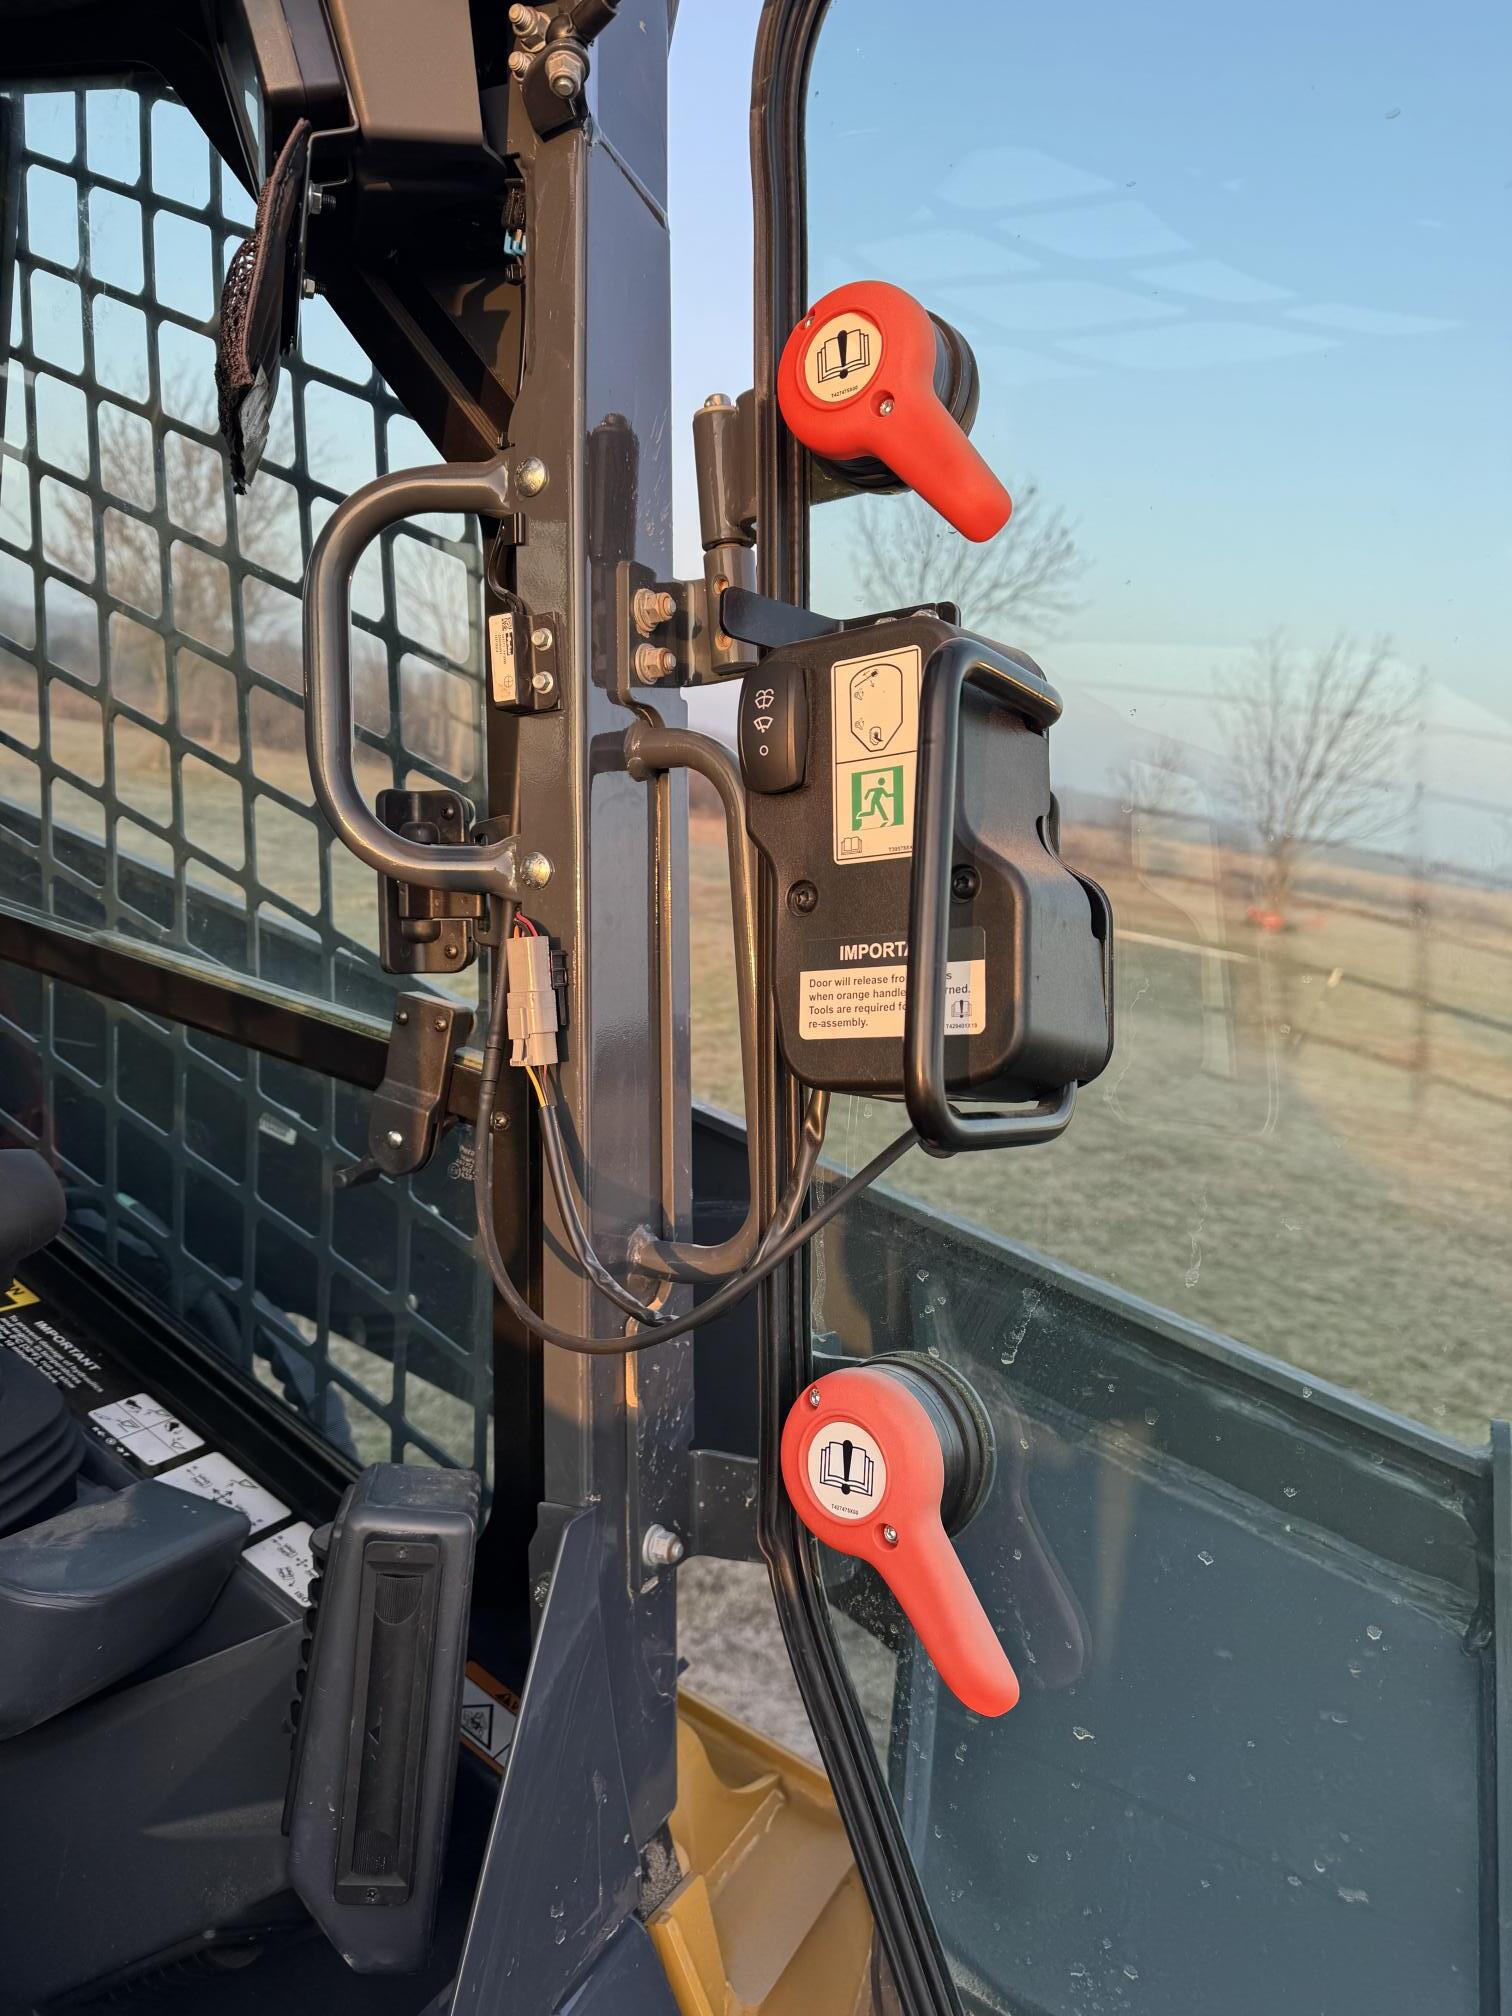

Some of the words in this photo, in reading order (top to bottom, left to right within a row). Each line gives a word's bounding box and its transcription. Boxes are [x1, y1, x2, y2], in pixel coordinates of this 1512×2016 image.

[839, 941, 908, 961] IMPORT
[809, 978, 831, 988] Door
[835, 977, 850, 987] will
[853, 976, 888, 986] release
[891, 974, 905, 983] fro
[809, 992, 834, 1002] when
[836, 991, 870, 1002] orange
[945, 984, 971, 994] rned.
[808, 1004, 834, 1015] Tools
[836, 1006, 852, 1014] are
[854, 1002, 896, 1014] required
[898, 1002, 907, 1012] fo
[808, 1018, 869, 1029] re-assembly.
[33, 1320, 102, 1371] IMPORTANT
